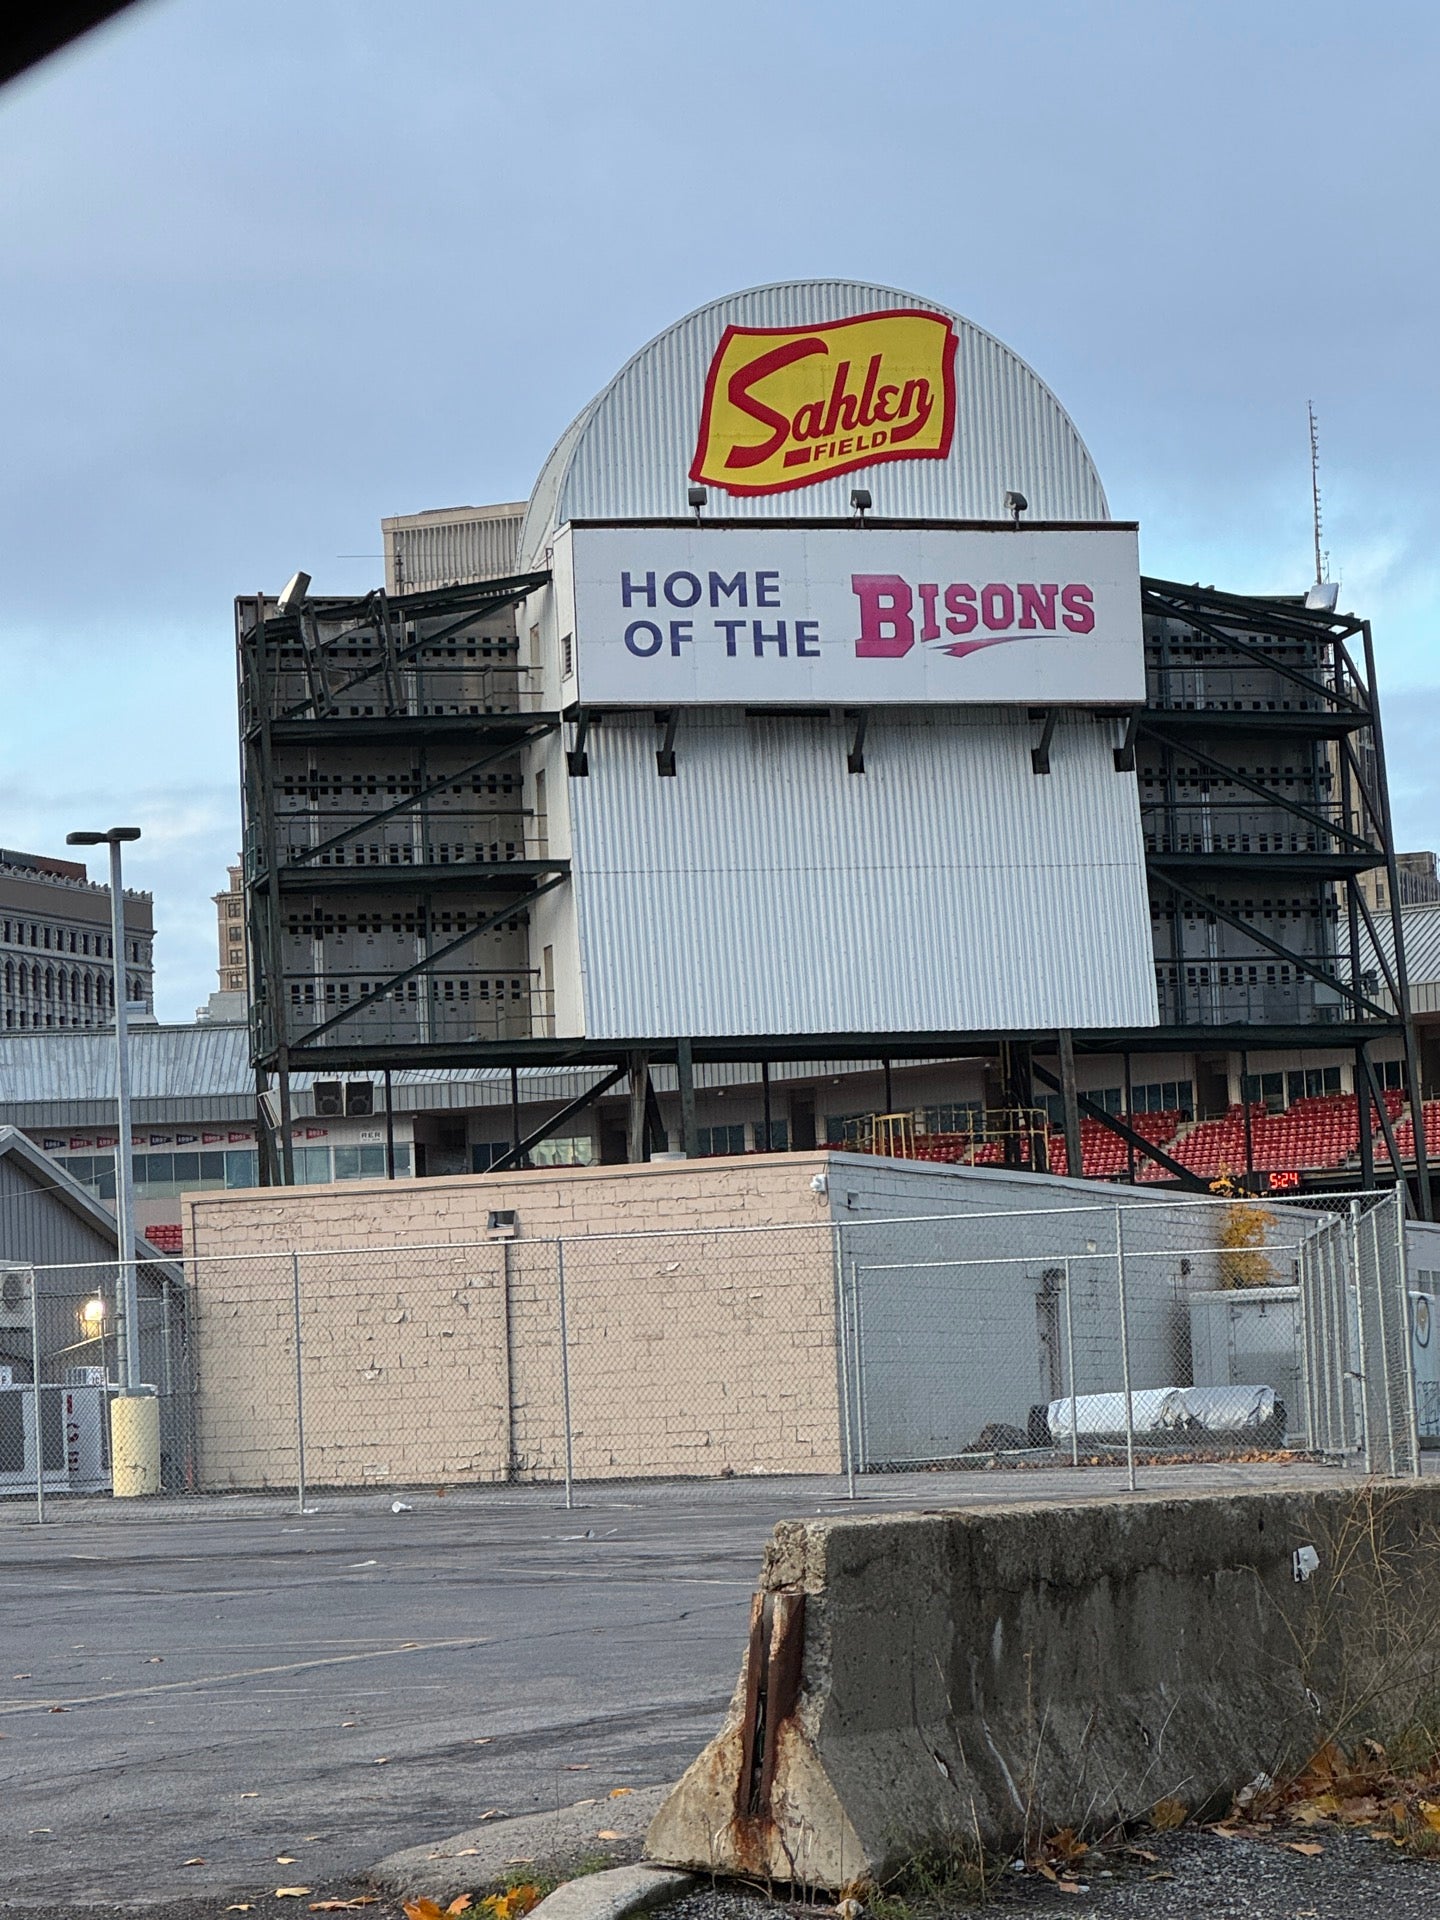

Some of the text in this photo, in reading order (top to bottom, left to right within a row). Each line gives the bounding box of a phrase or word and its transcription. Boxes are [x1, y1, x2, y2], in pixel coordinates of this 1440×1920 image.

[725, 338, 935, 469] Sahlen
[813, 430, 888, 462] FIELD
[620, 571, 782, 609] HOME
[851, 574, 1096, 658] BISONS
[624, 620, 821, 658] OF THE
[1270, 1172, 1298, 1189] 5:24
